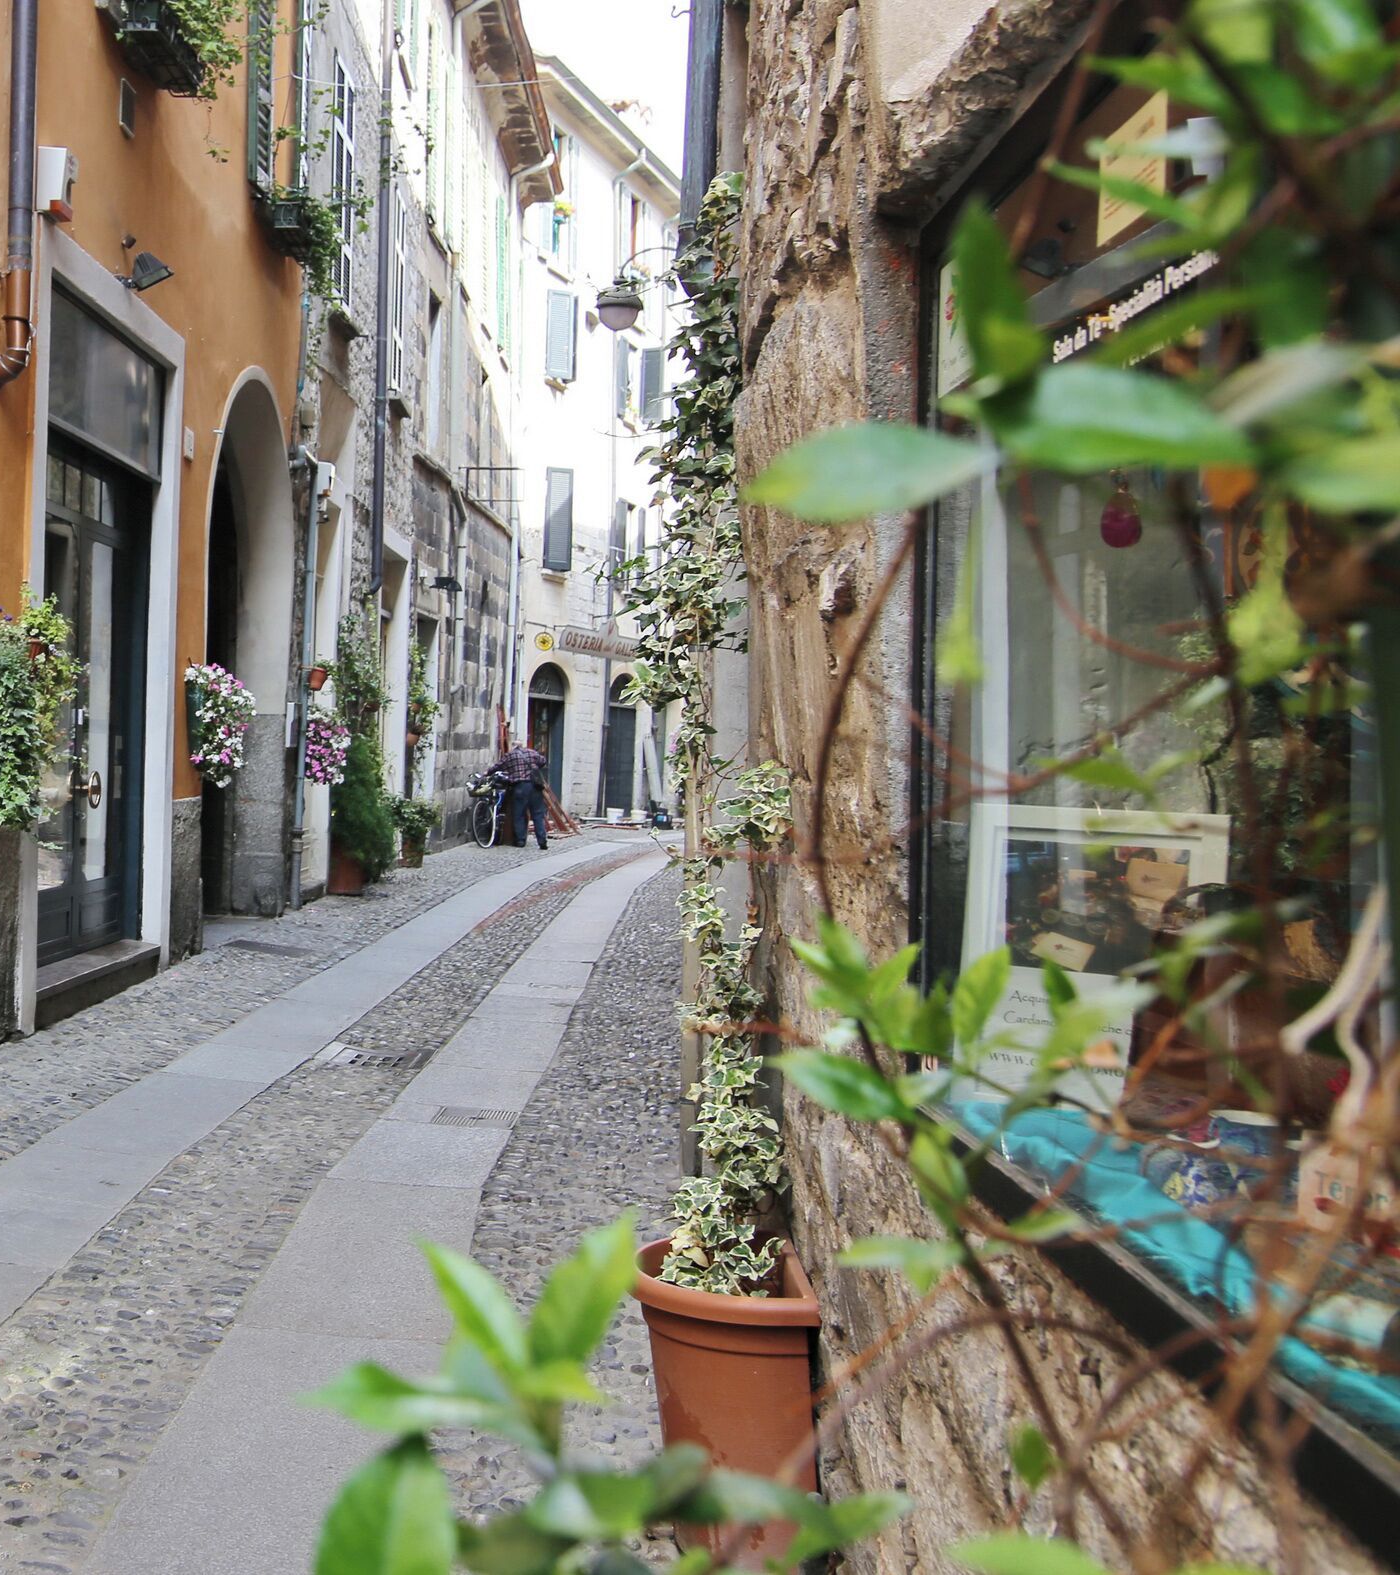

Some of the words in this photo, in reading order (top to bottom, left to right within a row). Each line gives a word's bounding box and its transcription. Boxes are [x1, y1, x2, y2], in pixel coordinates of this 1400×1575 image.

[1053, 335, 1073, 364] Sala
[1074, 326, 1087, 351] da
[565, 631, 603, 651] OSTERIA
